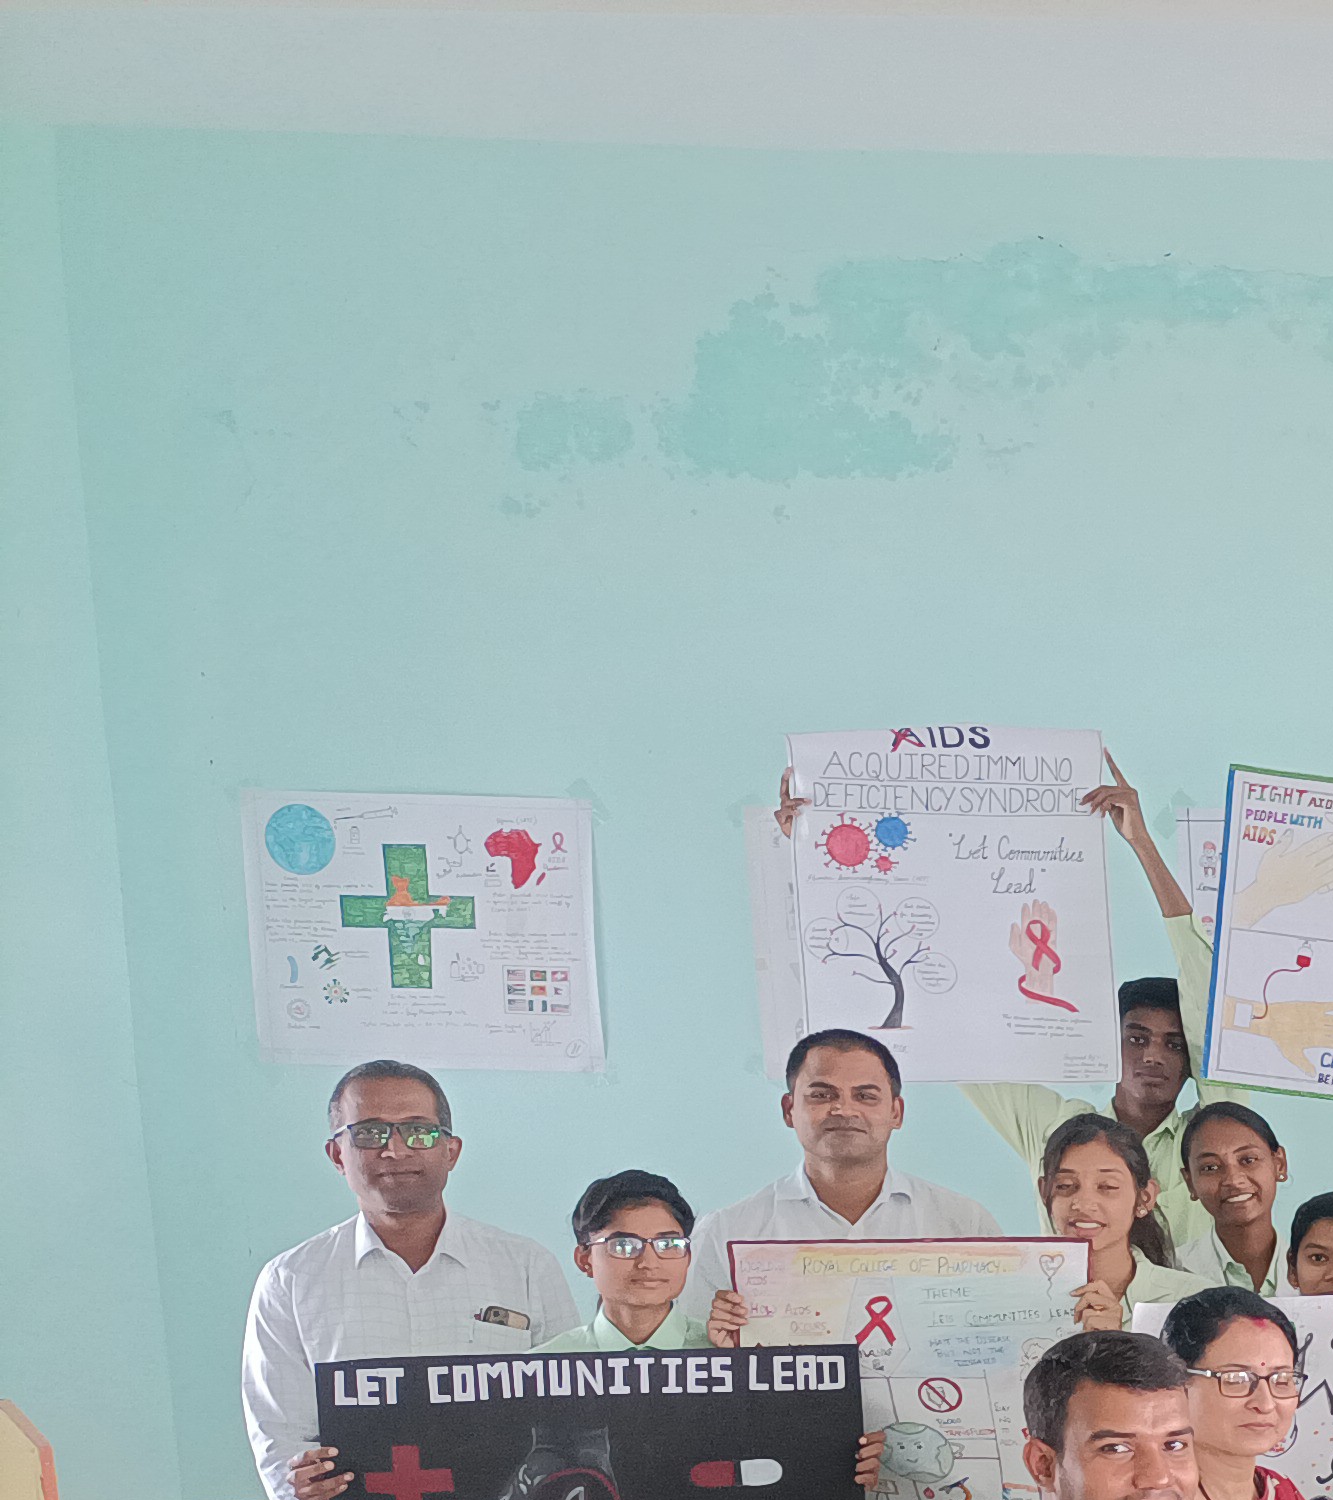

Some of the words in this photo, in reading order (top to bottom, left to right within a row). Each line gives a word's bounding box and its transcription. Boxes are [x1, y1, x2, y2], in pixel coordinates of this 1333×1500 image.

[891, 726, 991, 751] AIDS
[822, 751, 970, 781] ACQUIRED
[973, 754, 1073, 782] IMMUNO
[812, 782, 954, 812] DEFICIENCY
[959, 786, 1091, 814] SYNDROME
[1247, 784, 1306, 806] FIGHT
[1245, 808, 1288, 825] PEOPLE
[1289, 813, 1324, 830] WITH
[1242, 825, 1277, 846] AIDS
[909, 1258, 930, 1273] OF
[924, 1287, 972, 1299] THEME
[334, 1367, 405, 1406] LET
[428, 1356, 734, 1404] COMMUNITIES
[748, 1354, 846, 1392] LEAD
